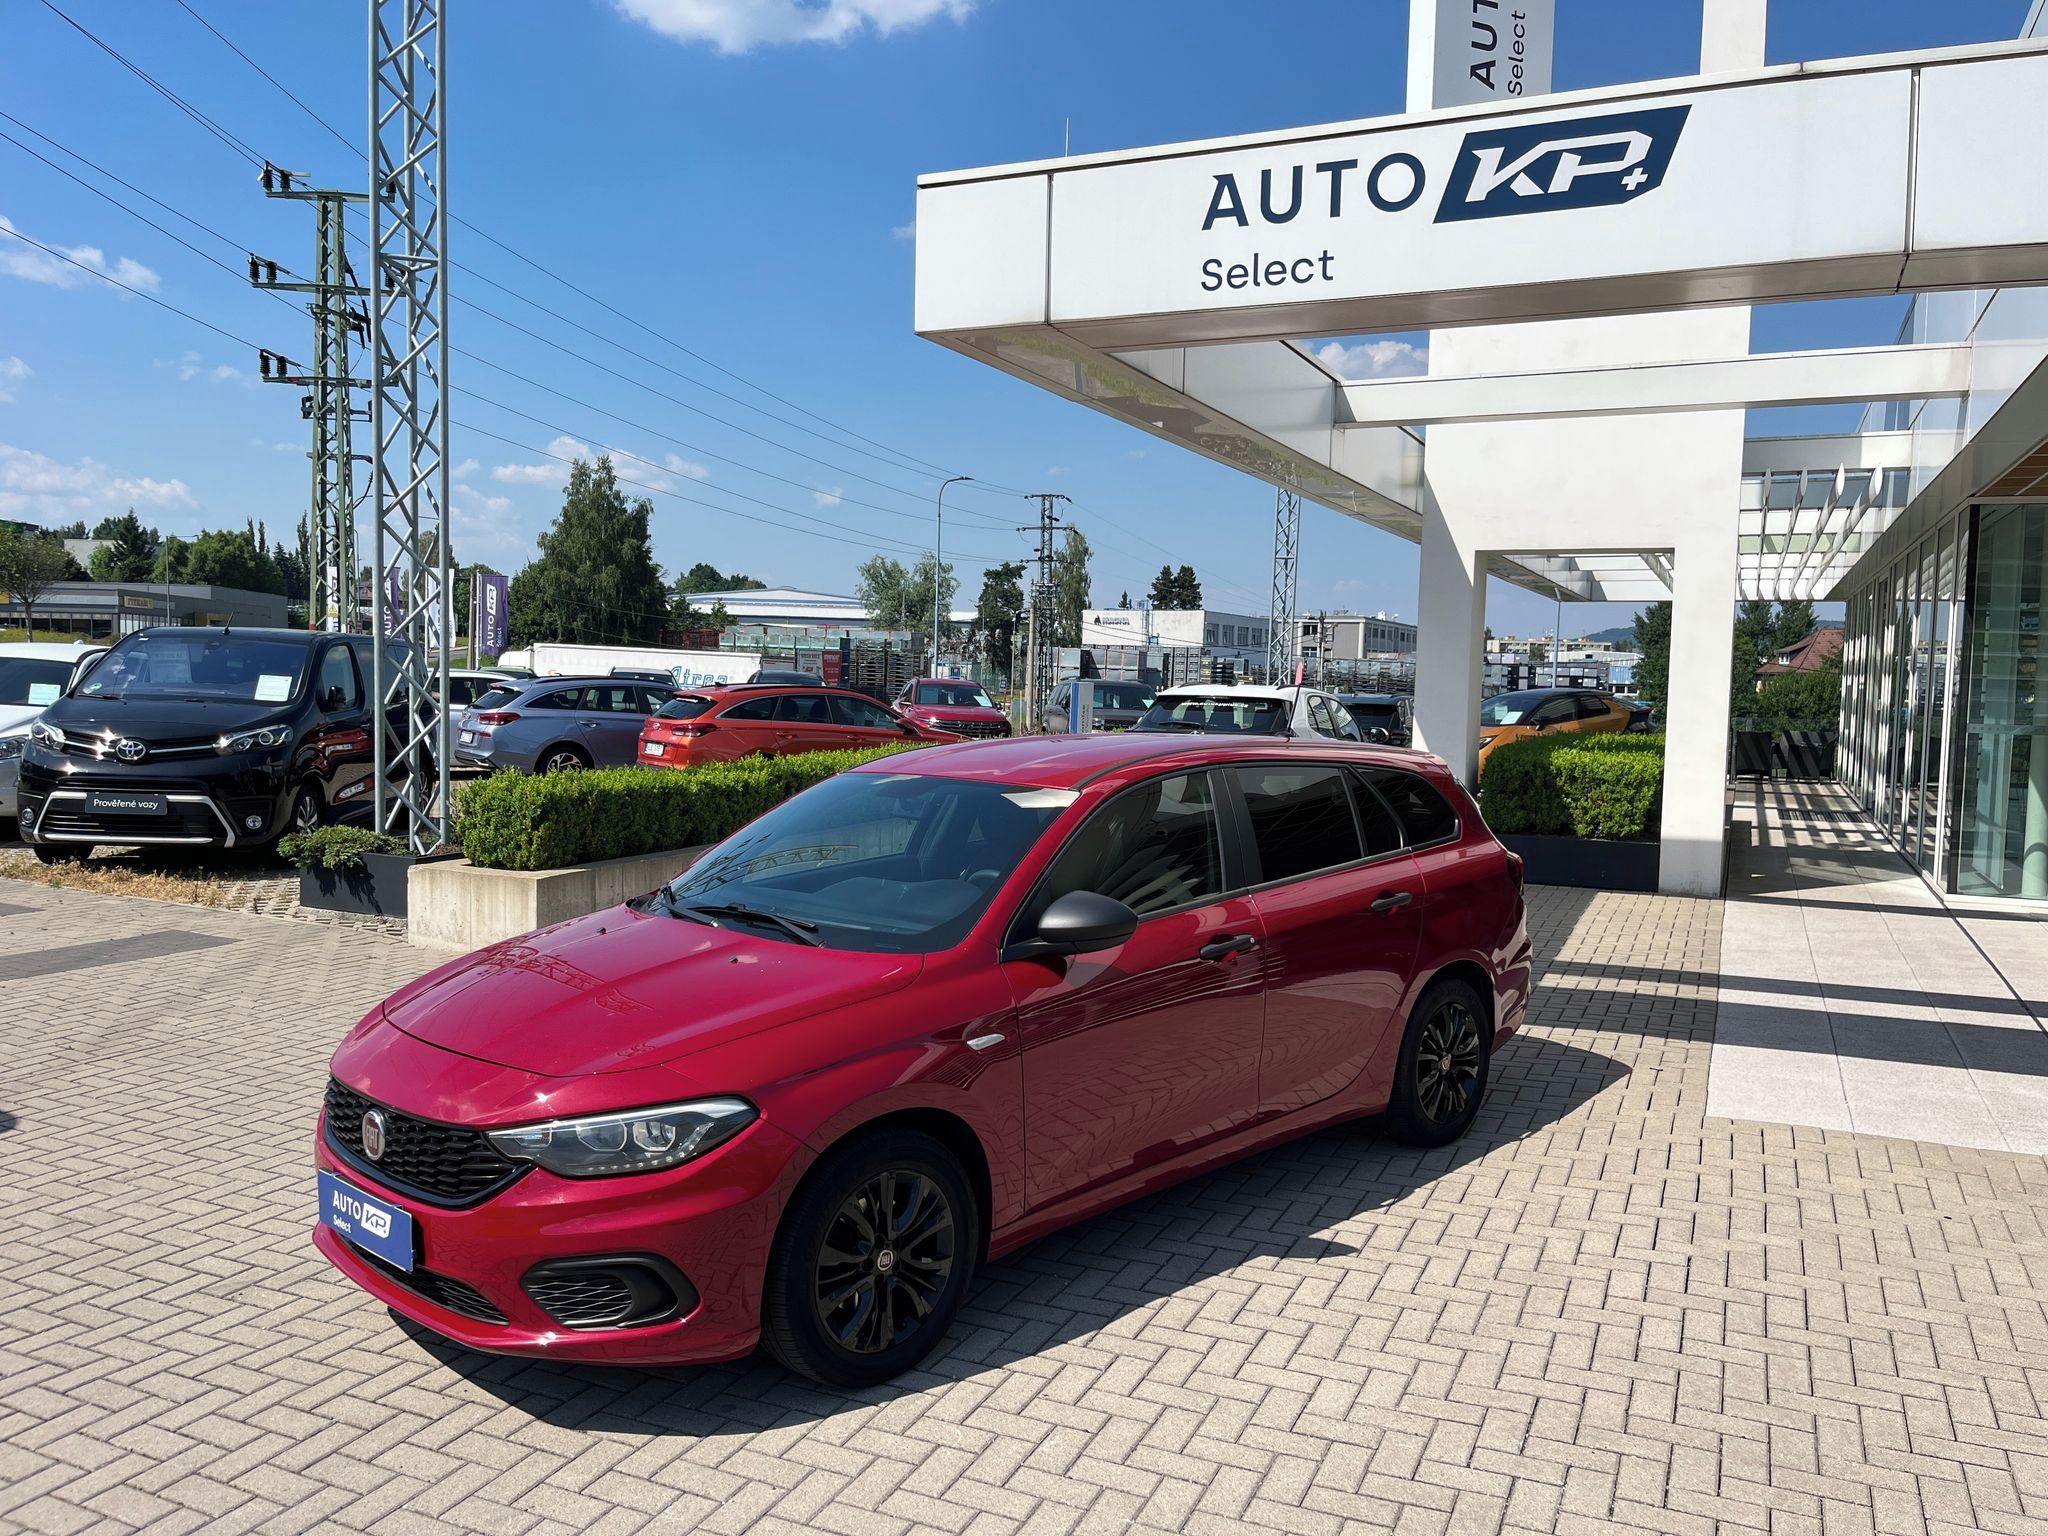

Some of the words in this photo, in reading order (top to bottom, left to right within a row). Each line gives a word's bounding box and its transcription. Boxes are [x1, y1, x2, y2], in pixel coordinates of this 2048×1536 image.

[1507, 10, 1526, 96] Select
[1201, 152, 1427, 231] AUTO
[1201, 250, 1335, 291] Select
[486, 615, 495, 648] AUTO
[93, 798, 137, 808] Prověřené
[138, 801, 159, 811] vozy
[333, 1190, 362, 1220] AUTO
[333, 1214, 352, 1234] Select
